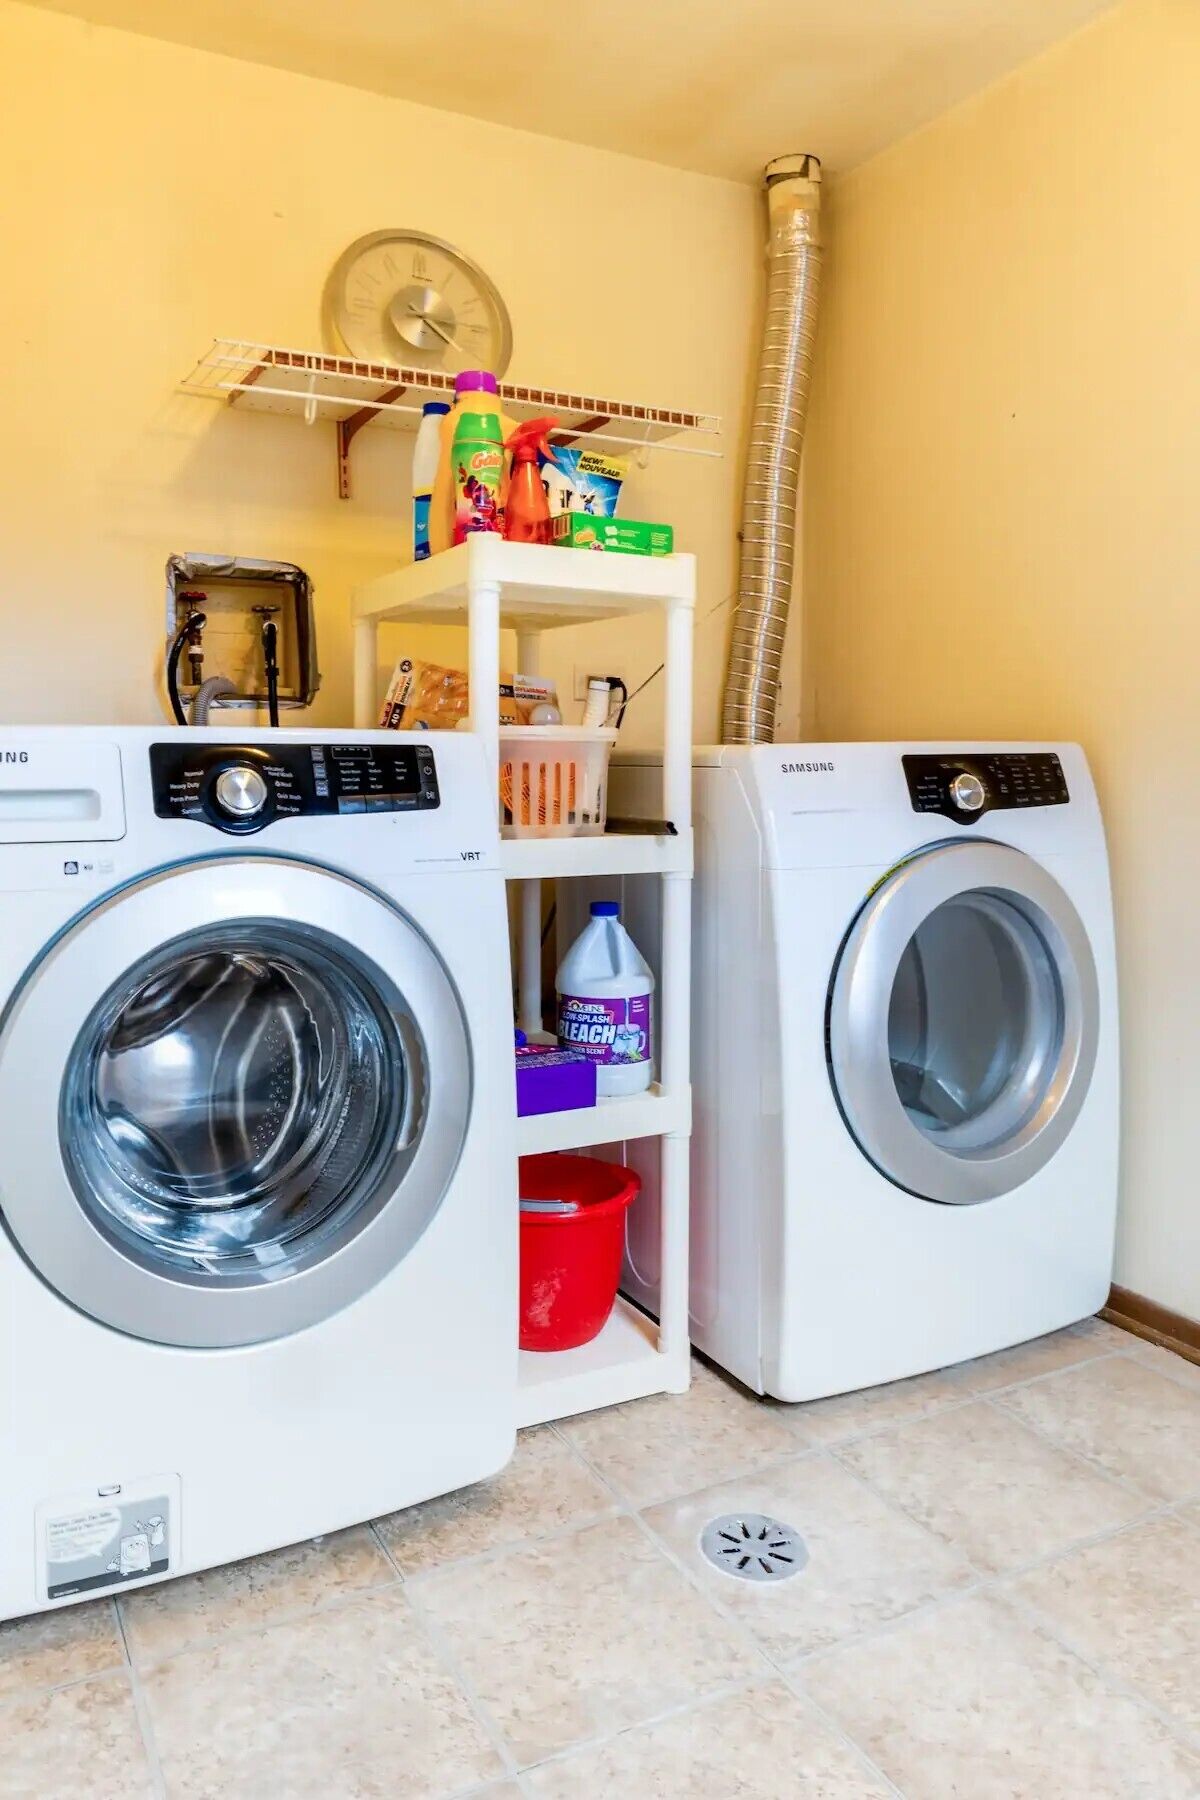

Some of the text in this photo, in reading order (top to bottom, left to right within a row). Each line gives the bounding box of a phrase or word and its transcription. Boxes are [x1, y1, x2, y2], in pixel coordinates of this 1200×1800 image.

[781, 762, 834, 774] SAMSUNG
[461, 851, 481, 861] VRT
[559, 1020, 617, 1044] BLEACH
